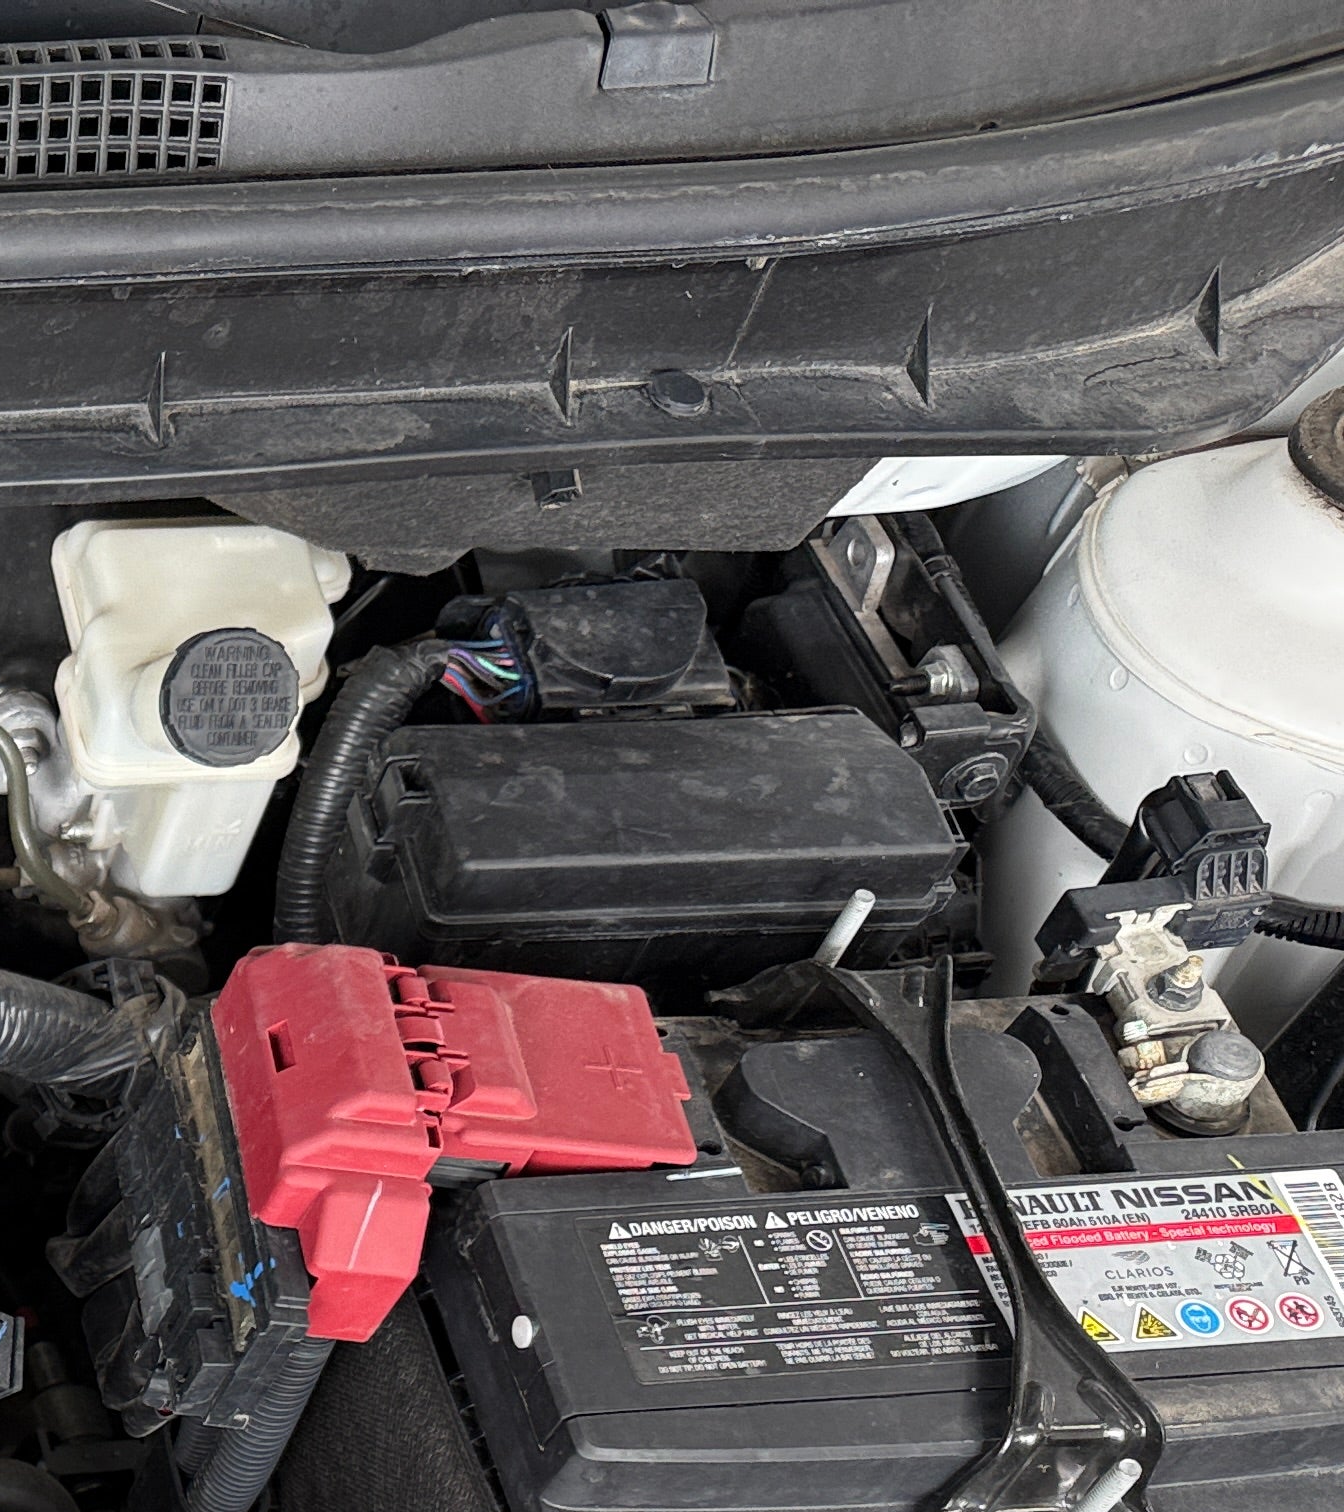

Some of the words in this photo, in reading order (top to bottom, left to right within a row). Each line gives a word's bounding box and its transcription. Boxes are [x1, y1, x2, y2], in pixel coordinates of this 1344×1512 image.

[190, 663, 223, 680] CLEAN
[262, 661, 283, 679] CAP
[1110, 1179, 1275, 1211] NISSAN
[627, 1214, 759, 1238] DANGER/POISON
[785, 1204, 921, 1227] PELIGRO/VENENO
[1052, 1216, 1087, 1229] 60Ah
[1088, 1213, 1123, 1227] 510A
[1123, 1211, 1151, 1227] (EN)
[1180, 1206, 1228, 1221] 24410
[1051, 1232, 1103, 1247] Flooded
[1103, 1230, 1150, 1245] Battery
[1160, 1225, 1205, 1242] Special
[1207, 1221, 1279, 1239] technology
[1104, 1265, 1175, 1281] CLARIOS
[1293, 1275, 1310, 1286] Pb
